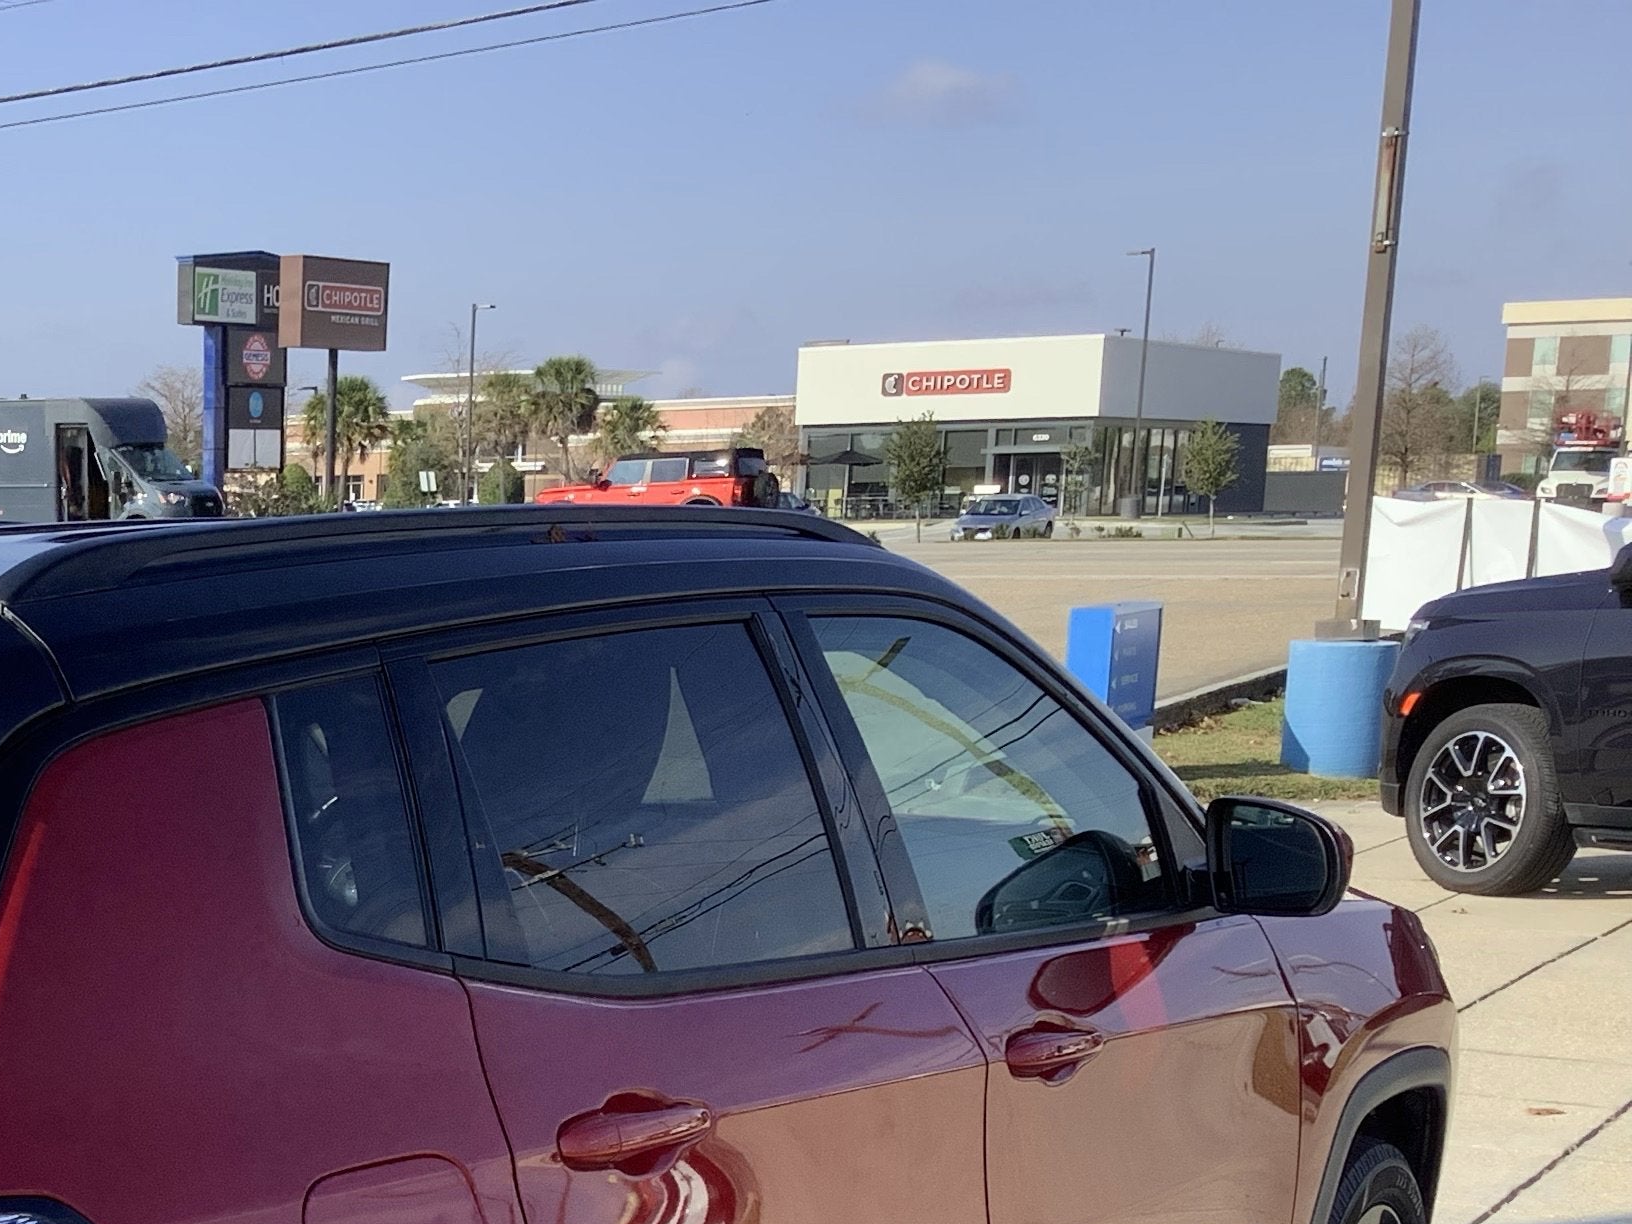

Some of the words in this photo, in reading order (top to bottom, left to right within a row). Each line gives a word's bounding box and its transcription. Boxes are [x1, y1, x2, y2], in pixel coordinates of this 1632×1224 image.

[220, 287, 254, 307] Express
[323, 290, 380, 308] CHIPOTLE
[331, 315, 360, 325] MEXICAN
[908, 373, 1005, 391] CHIPOTLE
